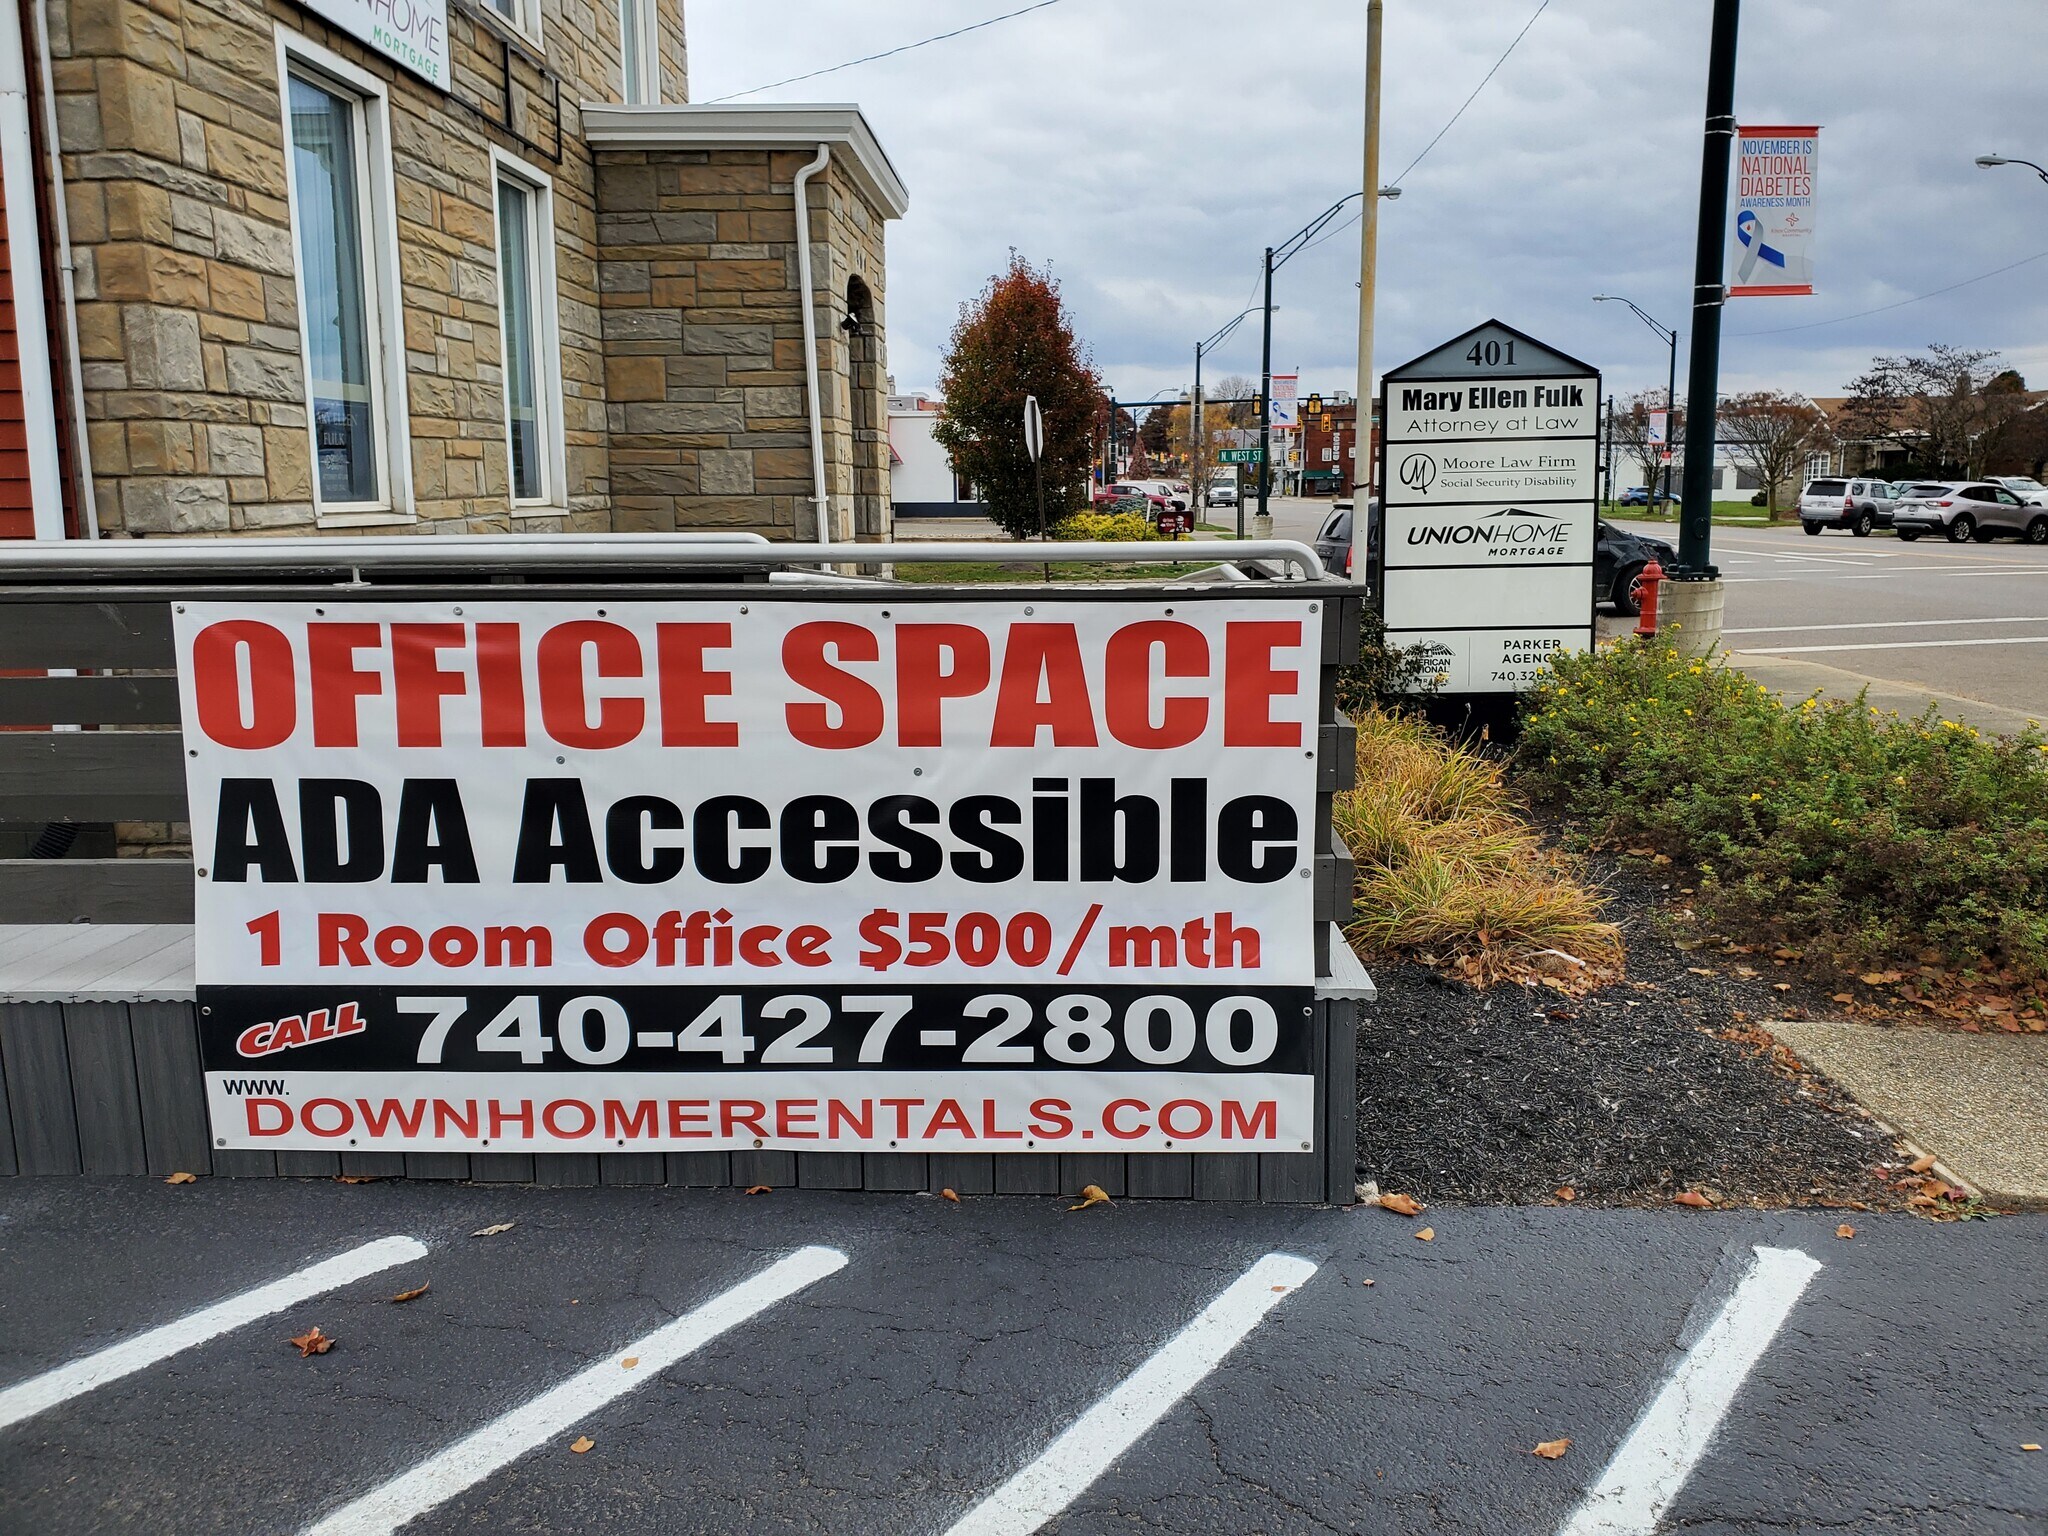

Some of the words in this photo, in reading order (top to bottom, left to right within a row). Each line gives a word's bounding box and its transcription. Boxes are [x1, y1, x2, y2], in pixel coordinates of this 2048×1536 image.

[373, 25, 439, 79] MORTGAGE
[1742, 140, 1800, 155] NOVEMBER
[1803, 140, 1813, 154] IS
[1741, 156, 1812, 175] NATIONAL
[1740, 177, 1811, 196] DIABETES
[1740, 198, 1785, 207] AWARENESS
[1786, 197, 1811, 207] MONTH
[1466, 340, 1517, 366] 401
[1402, 389, 1463, 412] Mary
[1468, 387, 1527, 409] Ellen
[1533, 385, 1583, 408] Fulk
[1406, 419, 1499, 434] Attorney
[1506, 416, 1528, 430] at
[1536, 415, 1579, 430] Law
[1231, 450, 1250, 462] WEST
[1252, 450, 1262, 461] ST
[1443, 457, 1495, 469] Moore
[1500, 457, 1533, 469] Law
[1538, 455, 1576, 468] Firm
[1440, 478, 1473, 488] Social
[1476, 478, 1521, 489] Security
[1524, 476, 1577, 488] Disability
[1407, 523, 1573, 545] UNIONHOME
[1488, 547, 1565, 557] MORTGAGE
[1504, 639, 1561, 650] PARKER
[193, 619, 739, 750] OFFICE
[782, 619, 1303, 750] SPACE
[211, 777, 481, 884] ADA
[512, 776, 1299, 885] Accessible
[246, 910, 282, 967] 1
[317, 912, 553, 968] Room
[583, 907, 832, 969] Office
[858, 903, 1262, 976] $500/mth
[235, 1000, 367, 1060] CALL
[396, 993, 1279, 1066] 740-427-2800
[246, 1098, 1278, 1140] DOWNHOMERENTALS.COM
